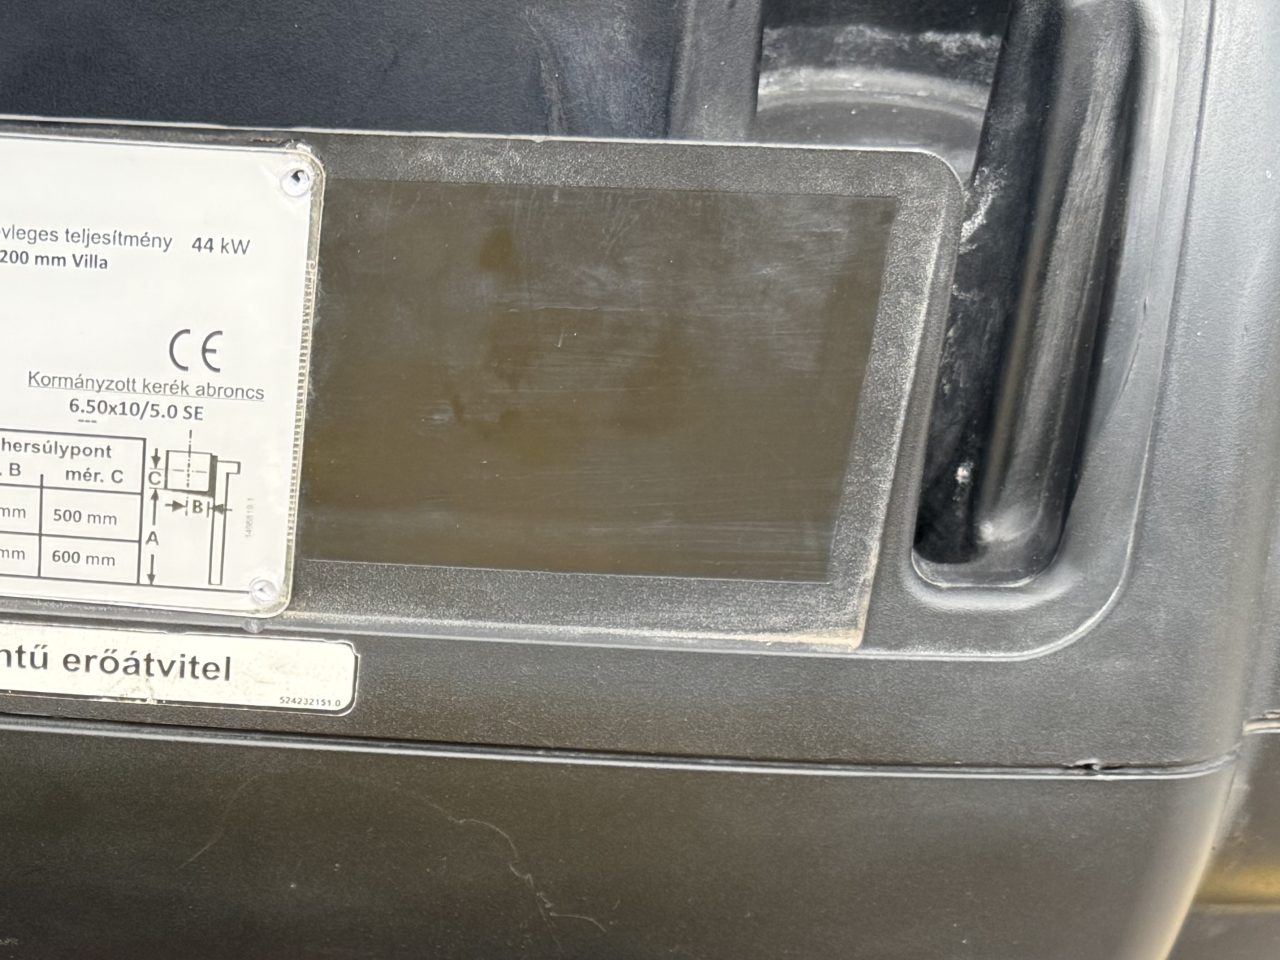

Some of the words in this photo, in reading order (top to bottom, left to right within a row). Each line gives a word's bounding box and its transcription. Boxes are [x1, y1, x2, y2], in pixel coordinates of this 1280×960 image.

[65, 227, 172, 252] teljesítmény
[192, 238, 214, 252] 44
[220, 238, 251, 255] kW
[34, 254, 67, 268] mm
[72, 253, 109, 269] Villa
[28, 370, 137, 394] Kormányzott
[143, 380, 190, 396] kerék
[195, 383, 265, 400] abroncs
[69, 398, 178, 420] 6.50x10/5.0
[182, 405, 204, 421] SE
[9, 462, 21, 477] B
[65, 468, 105, 483] mér.
[111, 469, 124, 484] C
[192, 500, 203, 513] B
[53, 509, 82, 523] 500
[87, 513, 117, 526] mm
[146, 531, 159, 545] A
[52, 550, 81, 564] 600
[86, 555, 116, 567] mm
[62, 646, 232, 683] erőátvitel
